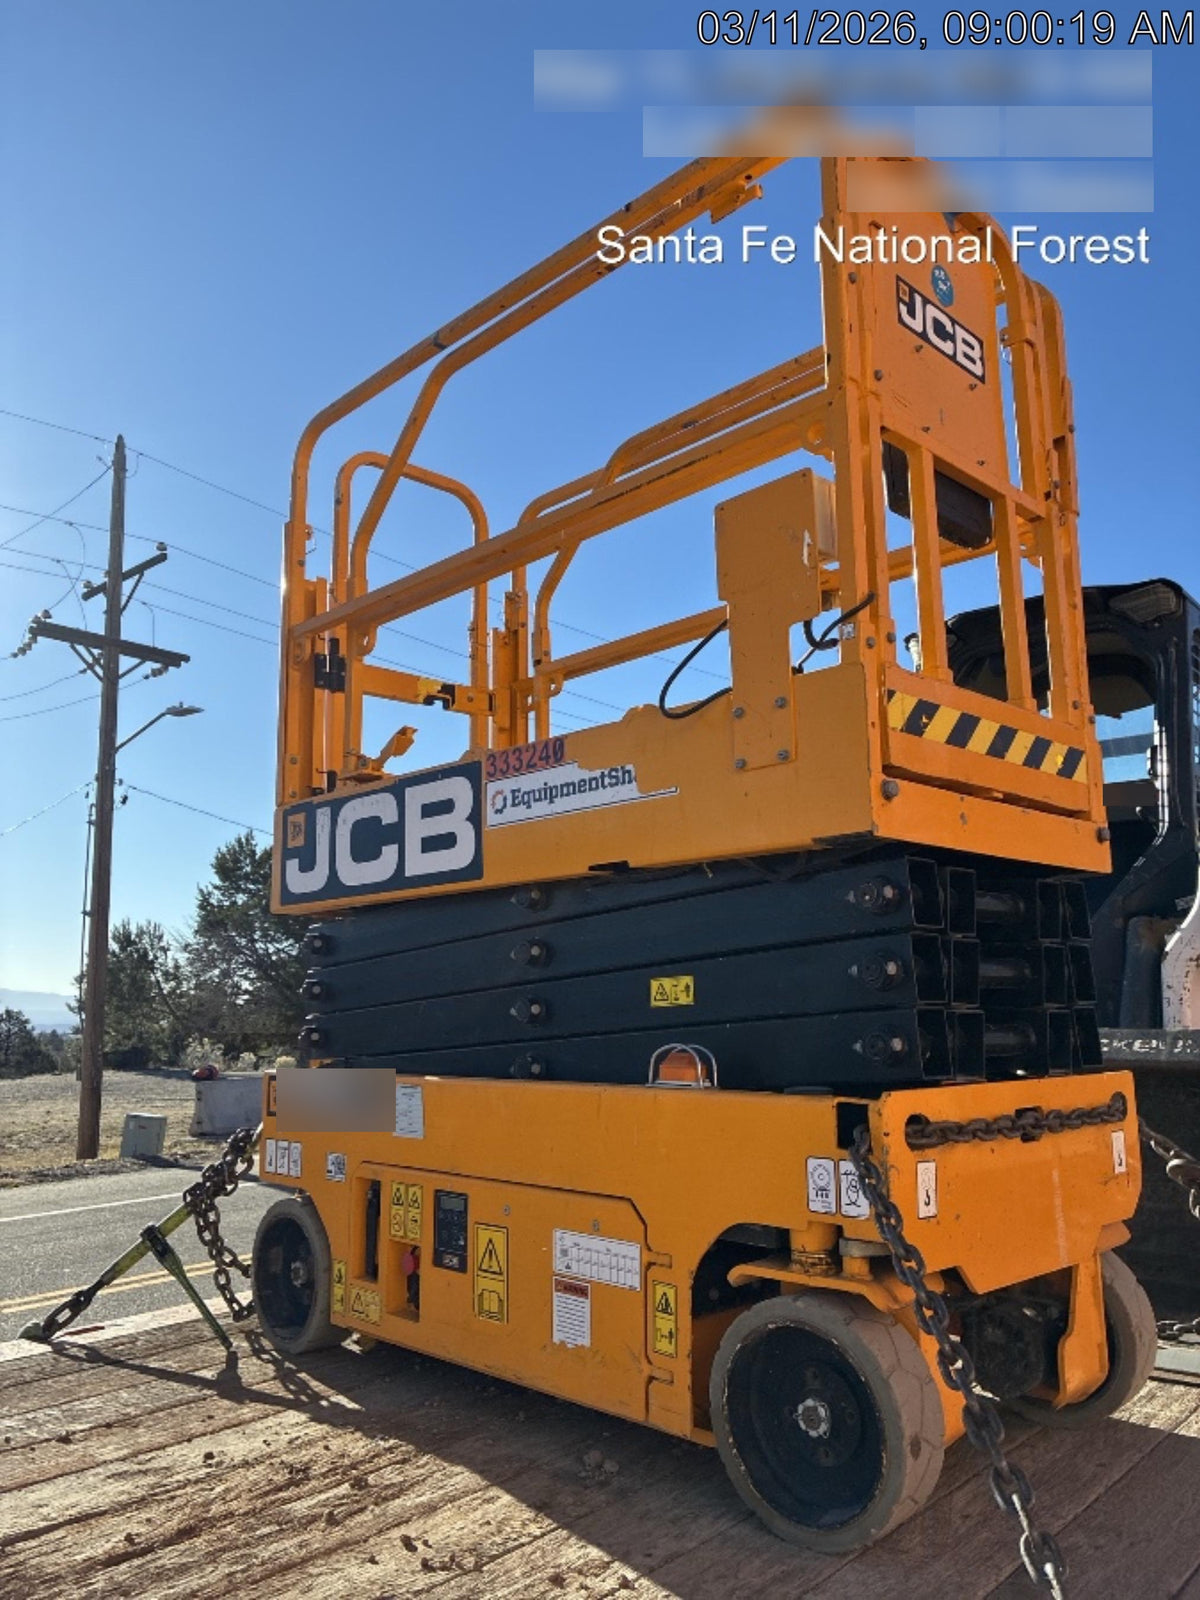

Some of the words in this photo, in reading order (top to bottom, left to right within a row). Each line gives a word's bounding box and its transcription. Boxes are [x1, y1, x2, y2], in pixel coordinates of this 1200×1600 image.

[899, 292, 984, 377] JCB
[486, 738, 566, 778] 333240
[510, 766, 637, 810] EquipmentSh
[285, 776, 476, 894] JCB
